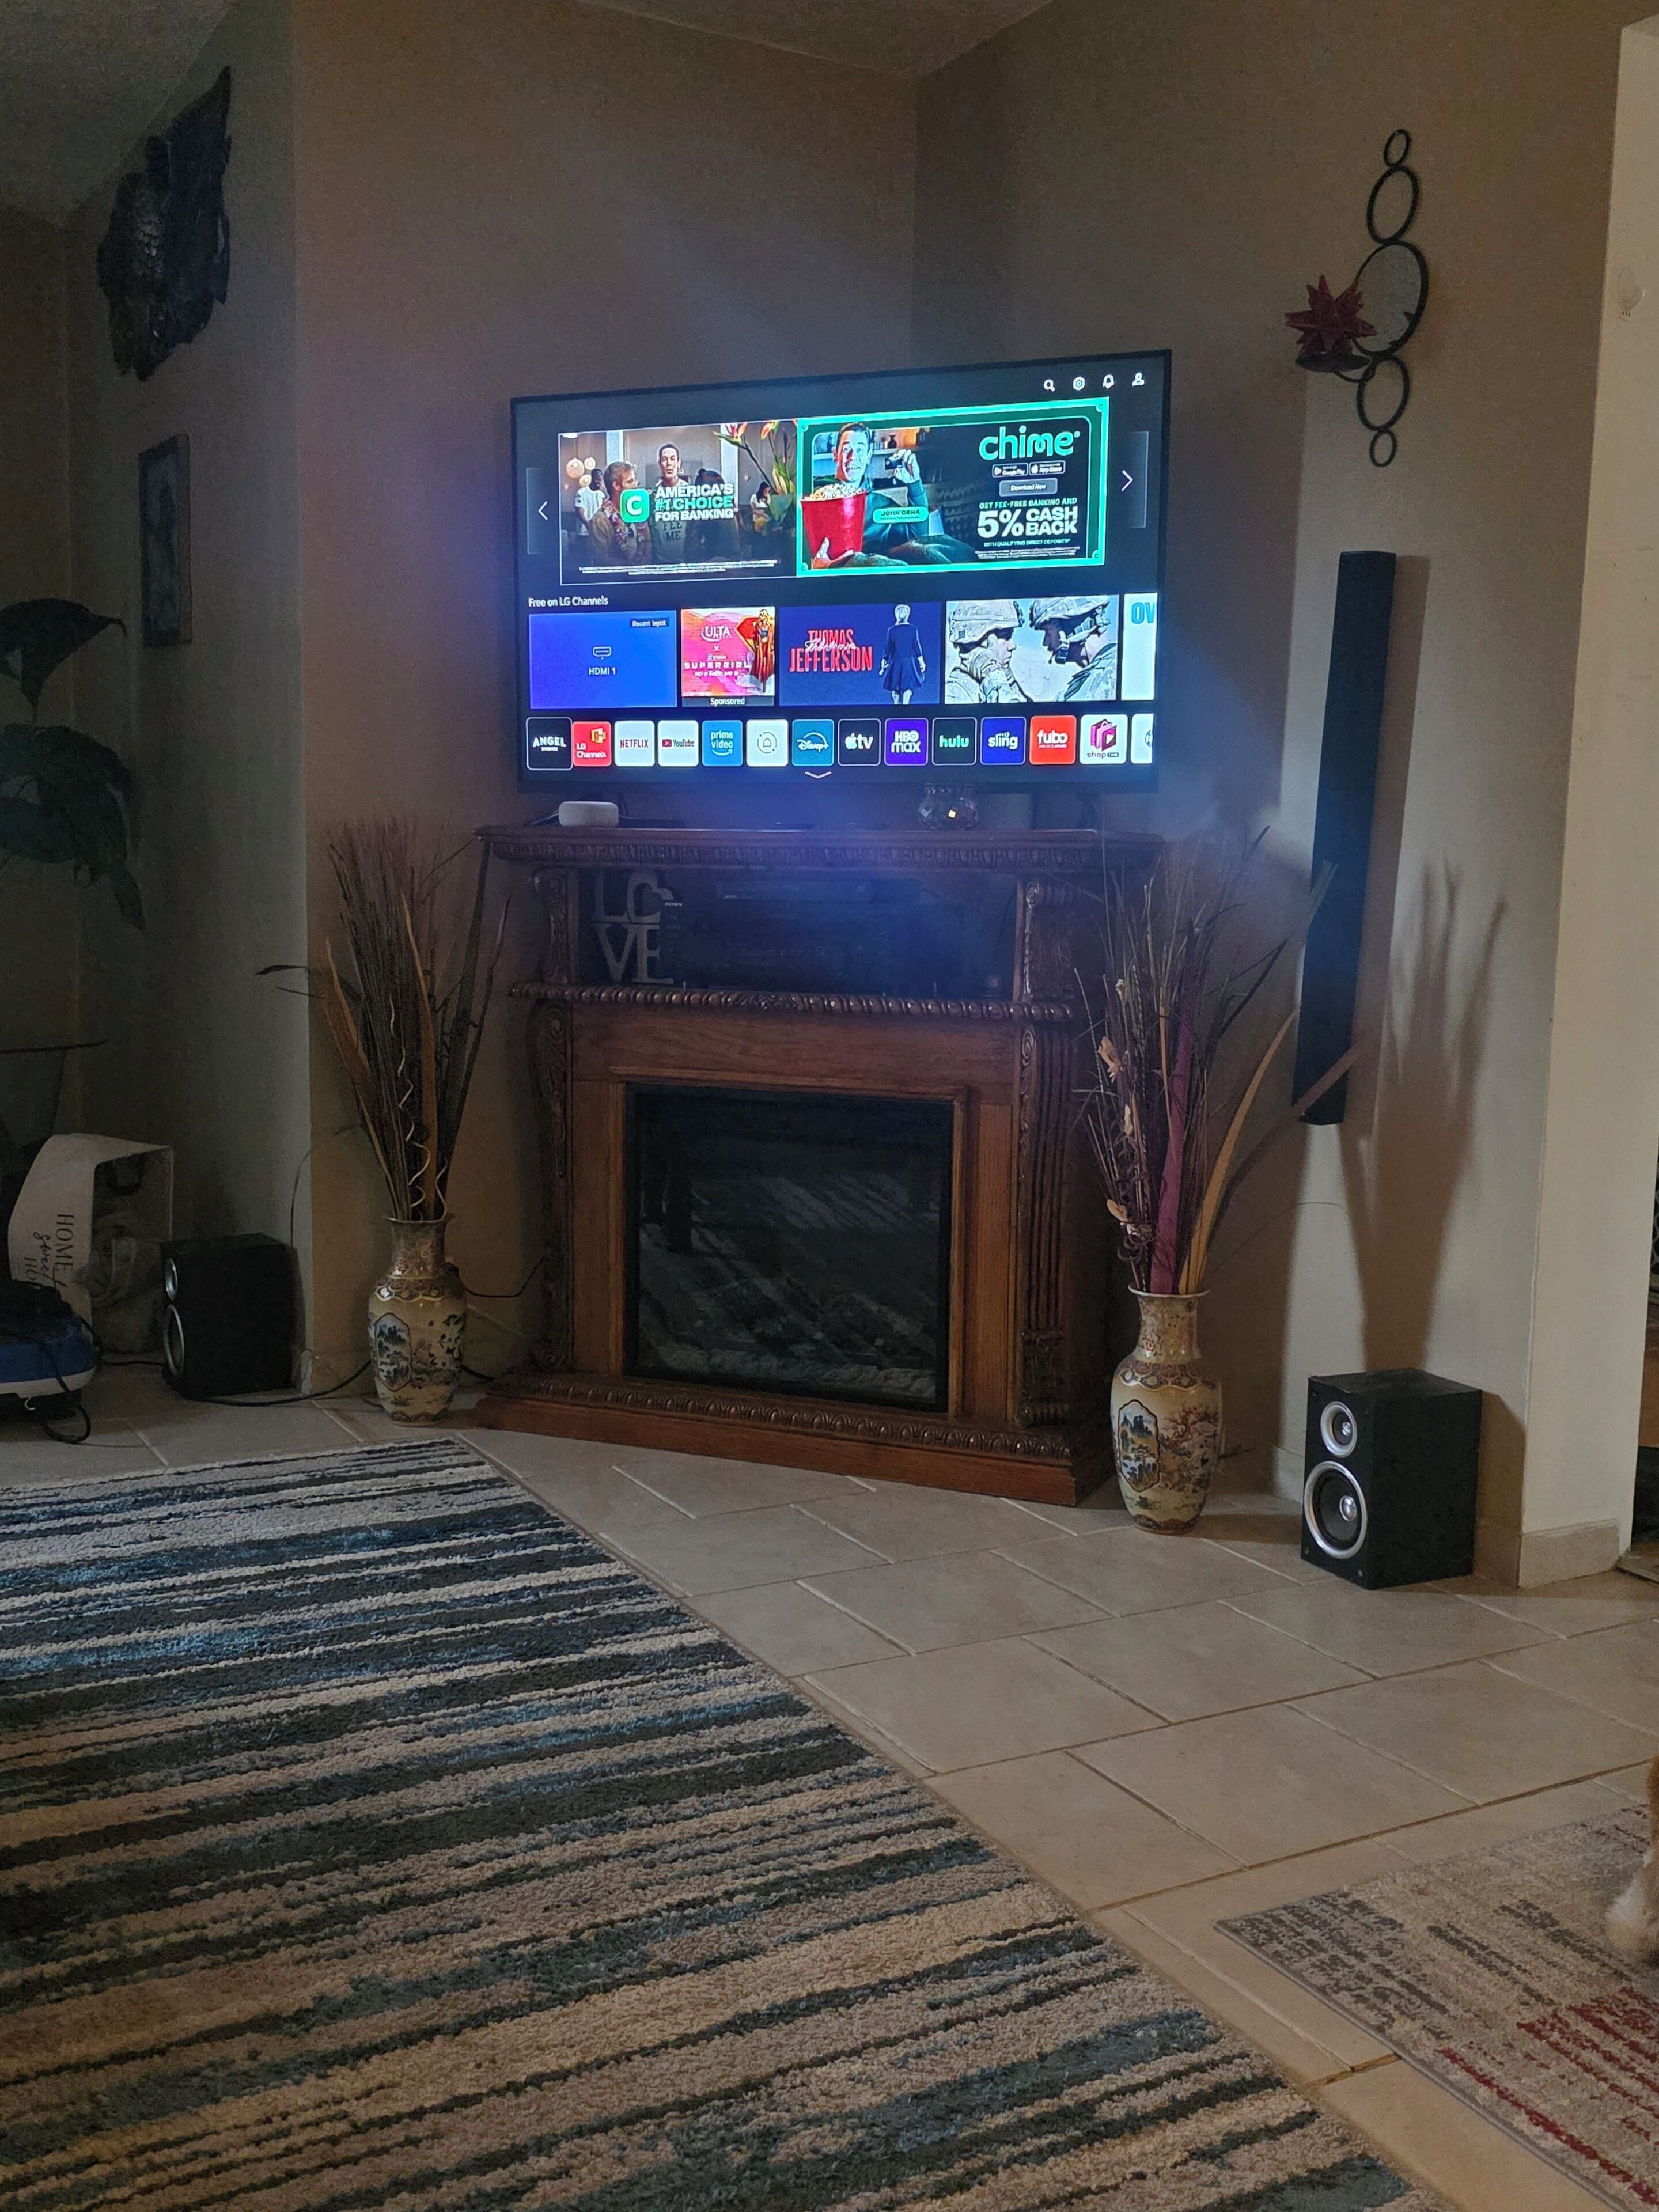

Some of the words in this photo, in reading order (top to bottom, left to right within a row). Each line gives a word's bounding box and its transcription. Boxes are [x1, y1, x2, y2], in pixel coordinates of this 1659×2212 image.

[979, 425, 1074, 460] chime
[656, 483, 734, 498] AMERICA'S
[655, 498, 671, 511] #1
[673, 495, 734, 510] CHOICE
[655, 511, 680, 522] FOR
[680, 508, 734, 521] BANKING
[1025, 506, 1078, 522] CASH
[977, 509, 1024, 539] 5%
[1025, 520, 1078, 536] BACK
[528, 598, 546, 607] Free
[559, 597, 571, 606] LG
[572, 595, 608, 605] Channels
[702, 626, 732, 641] ULTA
[684, 661, 751, 669] SUPERGIRL
[789, 646, 872, 672] JEFFERSON
[588, 667, 611, 675] HDMI
[710, 697, 745, 707] Sponsored
[710, 730, 734, 740] prime
[857, 734, 873, 749] tv
[895, 730, 919, 742] HBO
[939, 735, 969, 748] hulu
[988, 732, 1018, 749] sling
[1037, 729, 1068, 744] fubo
[532, 736, 567, 748] ANGEL
[576, 743, 586, 751] LG
[620, 739, 649, 749] NETFLIX
[673, 739, 695, 747] YouTube
[711, 740, 734, 749] video
[891, 741, 921, 753] max
[576, 751, 607, 759] Channels
[55, 1213, 75, 1272] HOME
